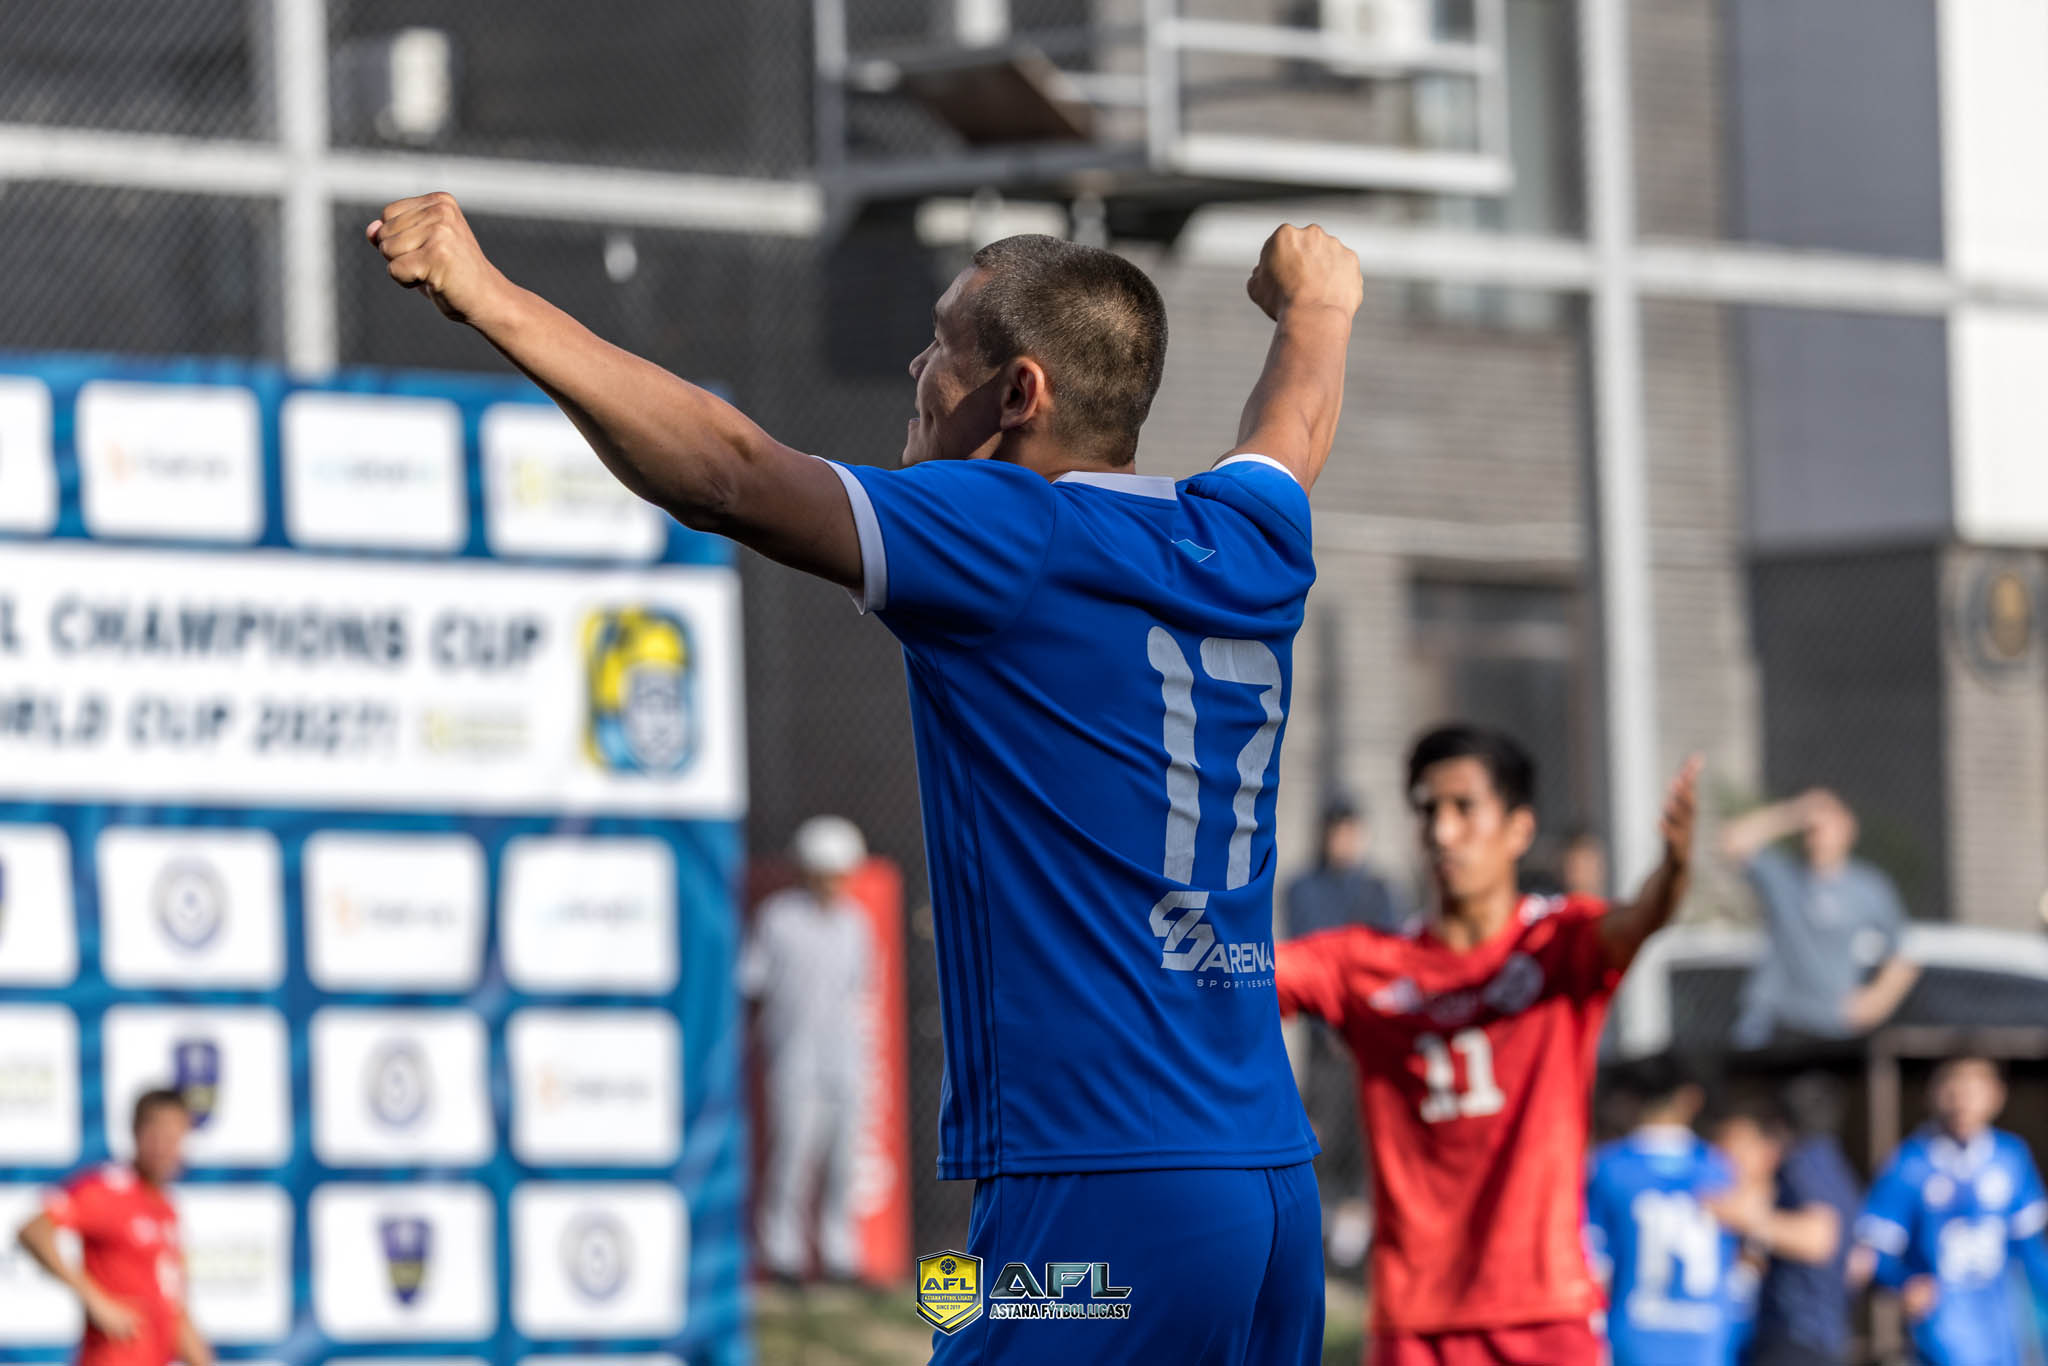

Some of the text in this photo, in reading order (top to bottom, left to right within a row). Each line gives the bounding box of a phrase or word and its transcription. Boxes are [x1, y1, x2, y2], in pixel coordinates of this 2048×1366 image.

[49, 596, 410, 669] CHAMPIONS
[429, 611, 548, 673] CUP
[128, 697, 234, 745] CUP
[1147, 626, 1283, 891] 17
[1413, 1029, 1506, 1123] 11
